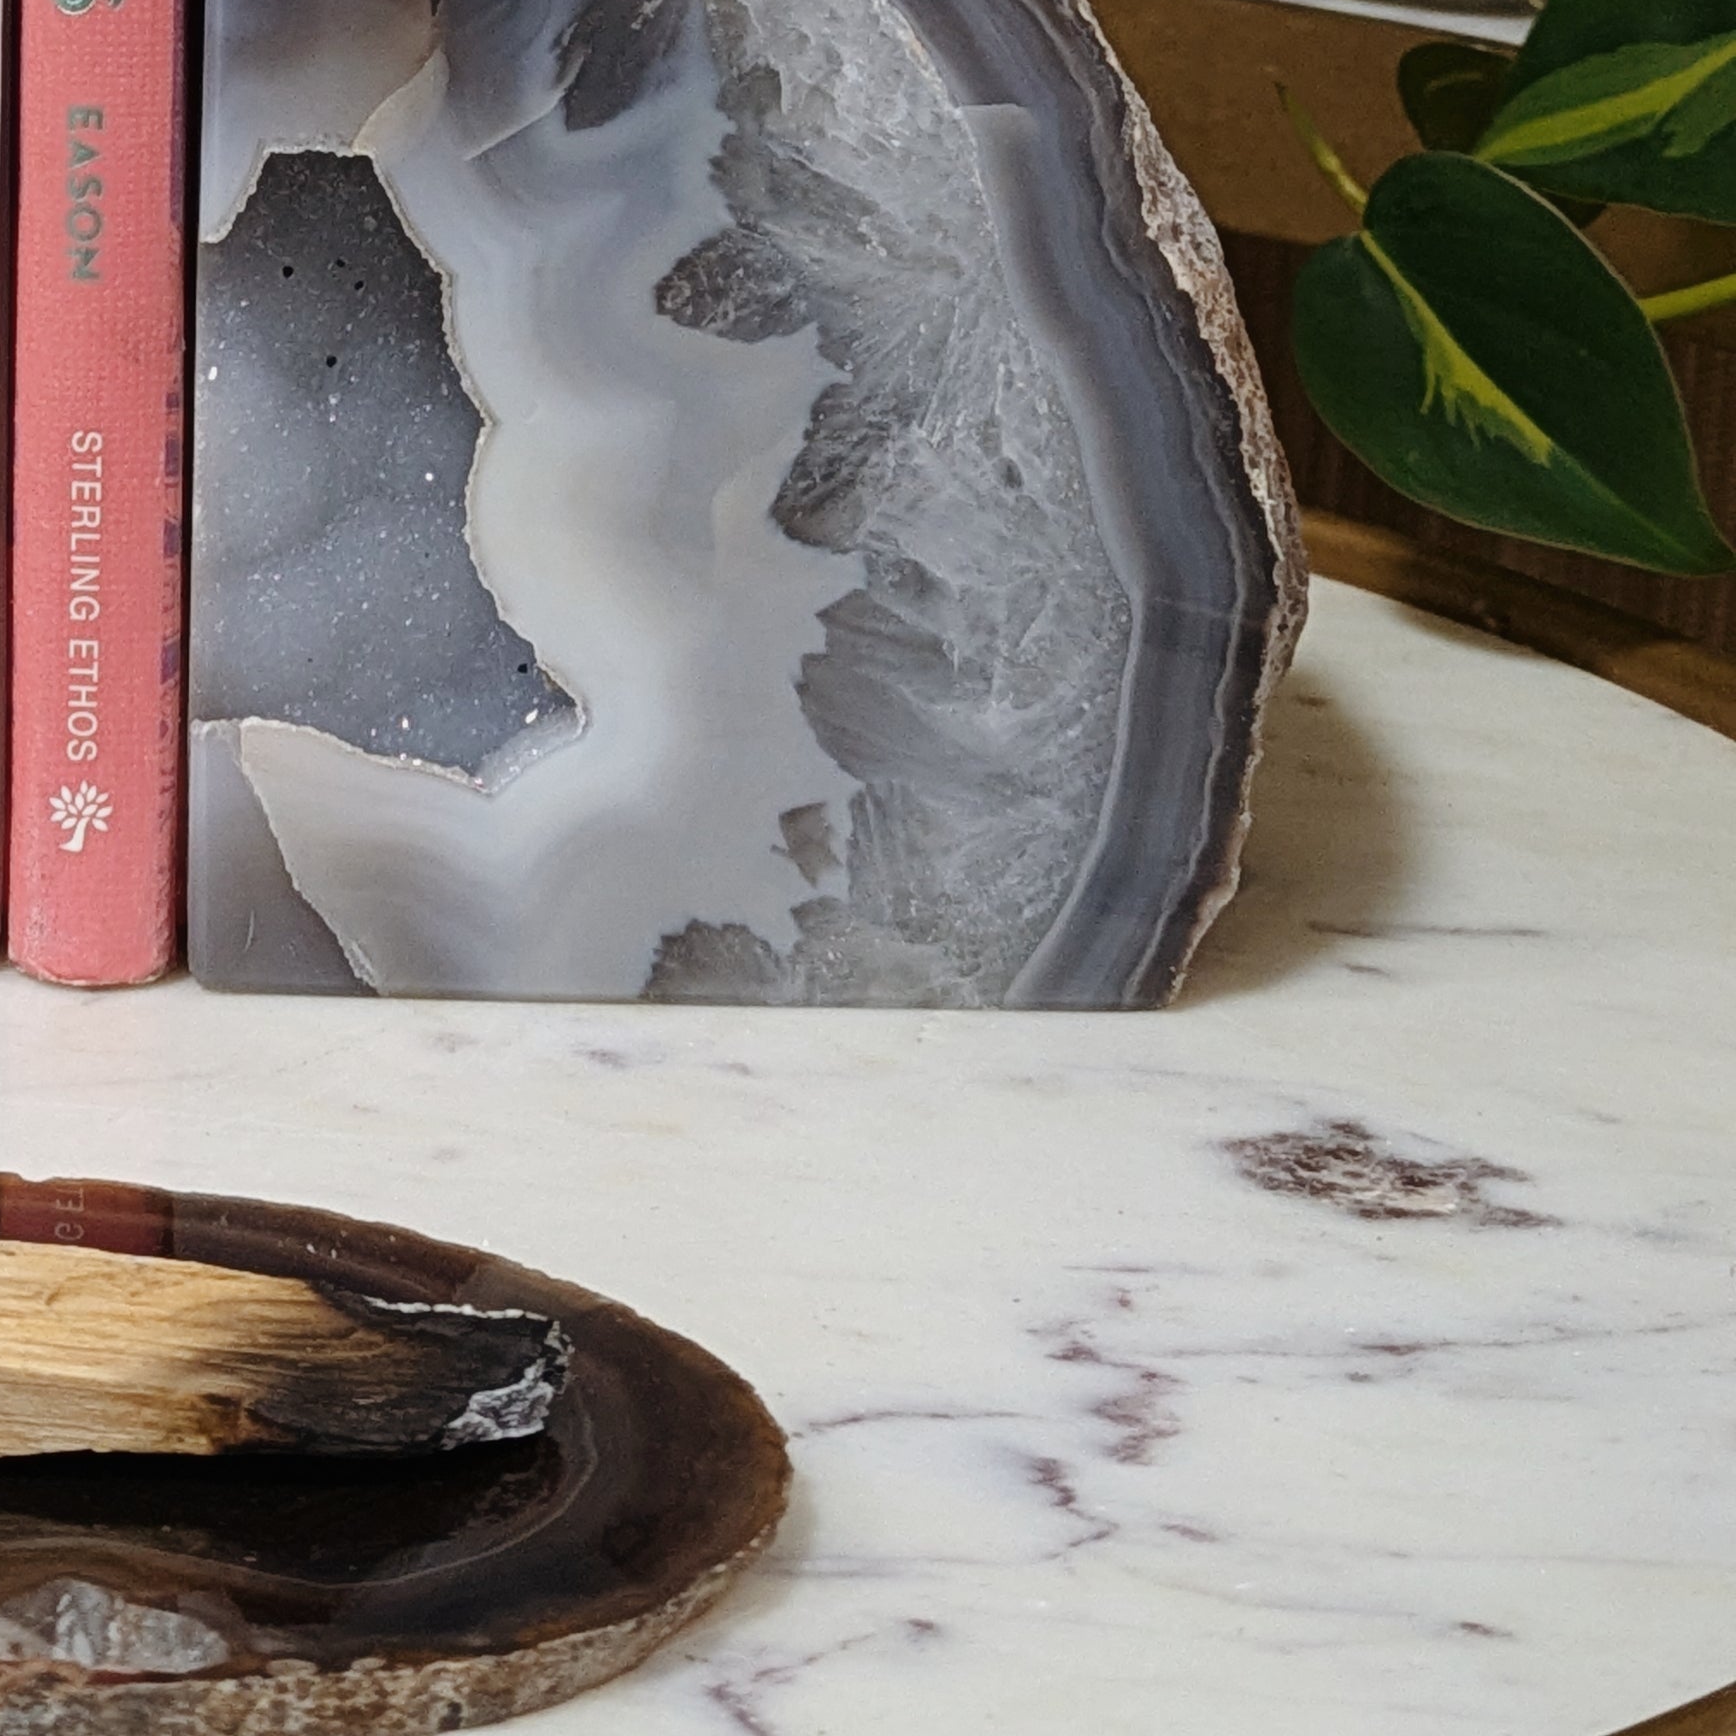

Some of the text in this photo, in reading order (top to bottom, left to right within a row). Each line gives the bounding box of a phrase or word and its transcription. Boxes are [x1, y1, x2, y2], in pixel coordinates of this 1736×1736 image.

[66, 106, 106, 284] EASON
[66, 429, 102, 762] STERLING ETHOS
